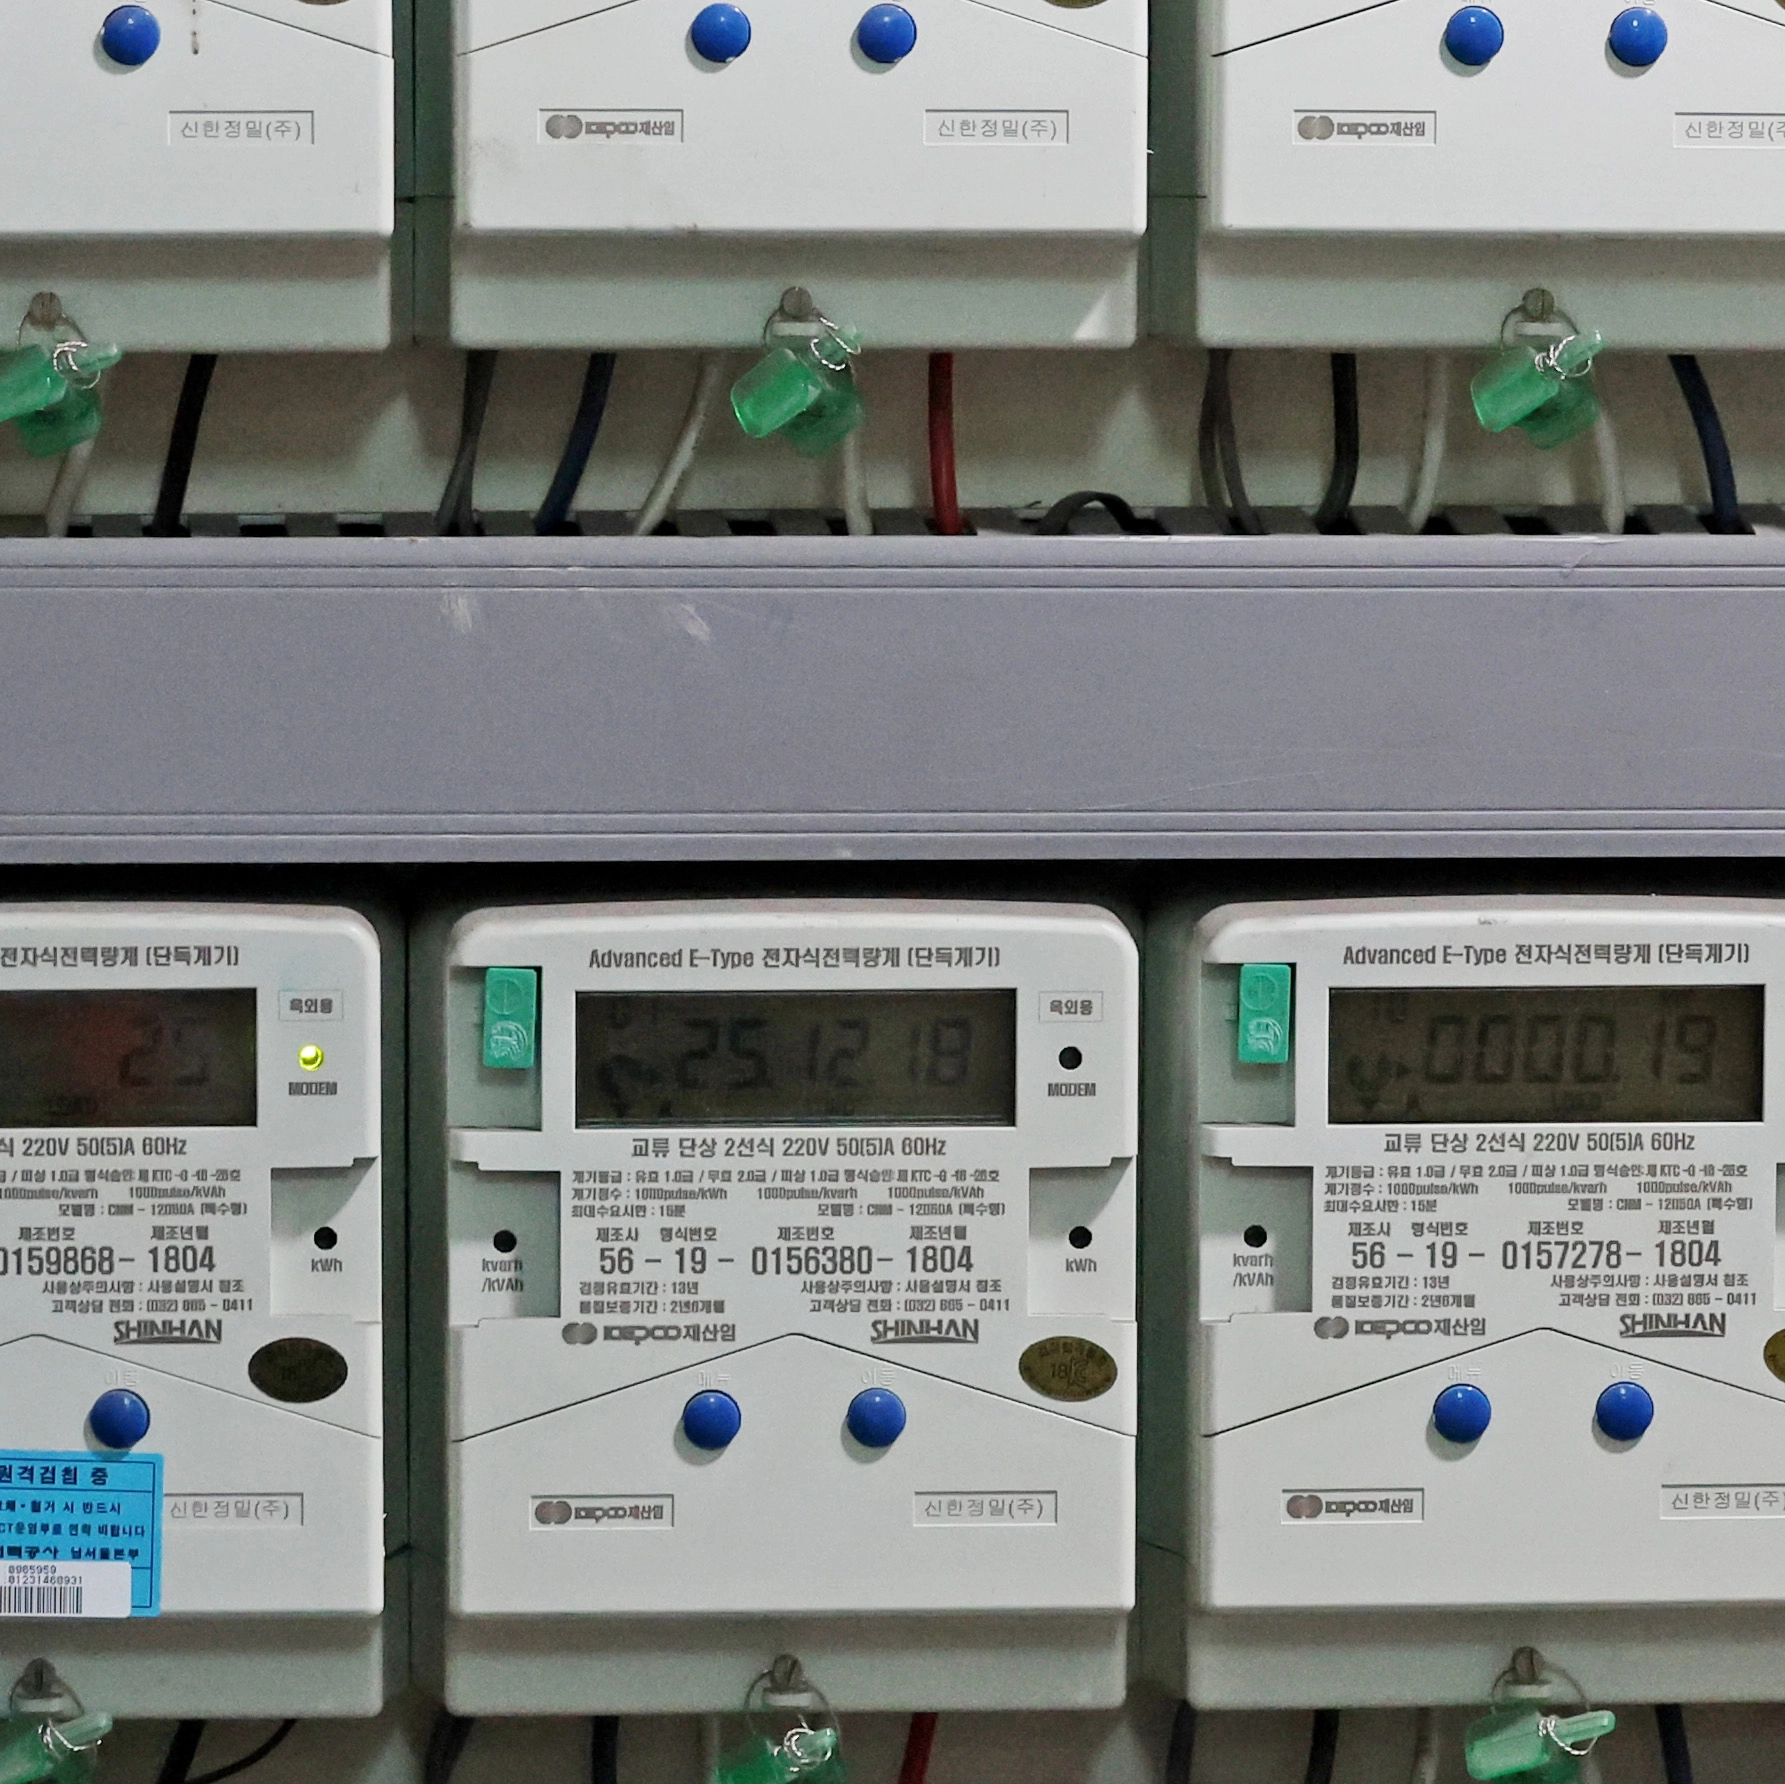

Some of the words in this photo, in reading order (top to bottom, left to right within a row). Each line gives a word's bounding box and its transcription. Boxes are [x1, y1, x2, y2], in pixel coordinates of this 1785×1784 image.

[589, 949, 682, 968] Advanced
[690, 948, 754, 969] E-Type
[1343, 945, 1436, 964] Advanced
[1443, 945, 1506, 966] E-Type
[148, 1245, 216, 1273] 1804
[907, 1245, 974, 1273] 1804
[1352, 1242, 1385, 1269] 56
[1426, 1241, 1457, 1268] 19
[1655, 1240, 1722, 1267] 1804
[91, 1467, 109, 1486] 중
